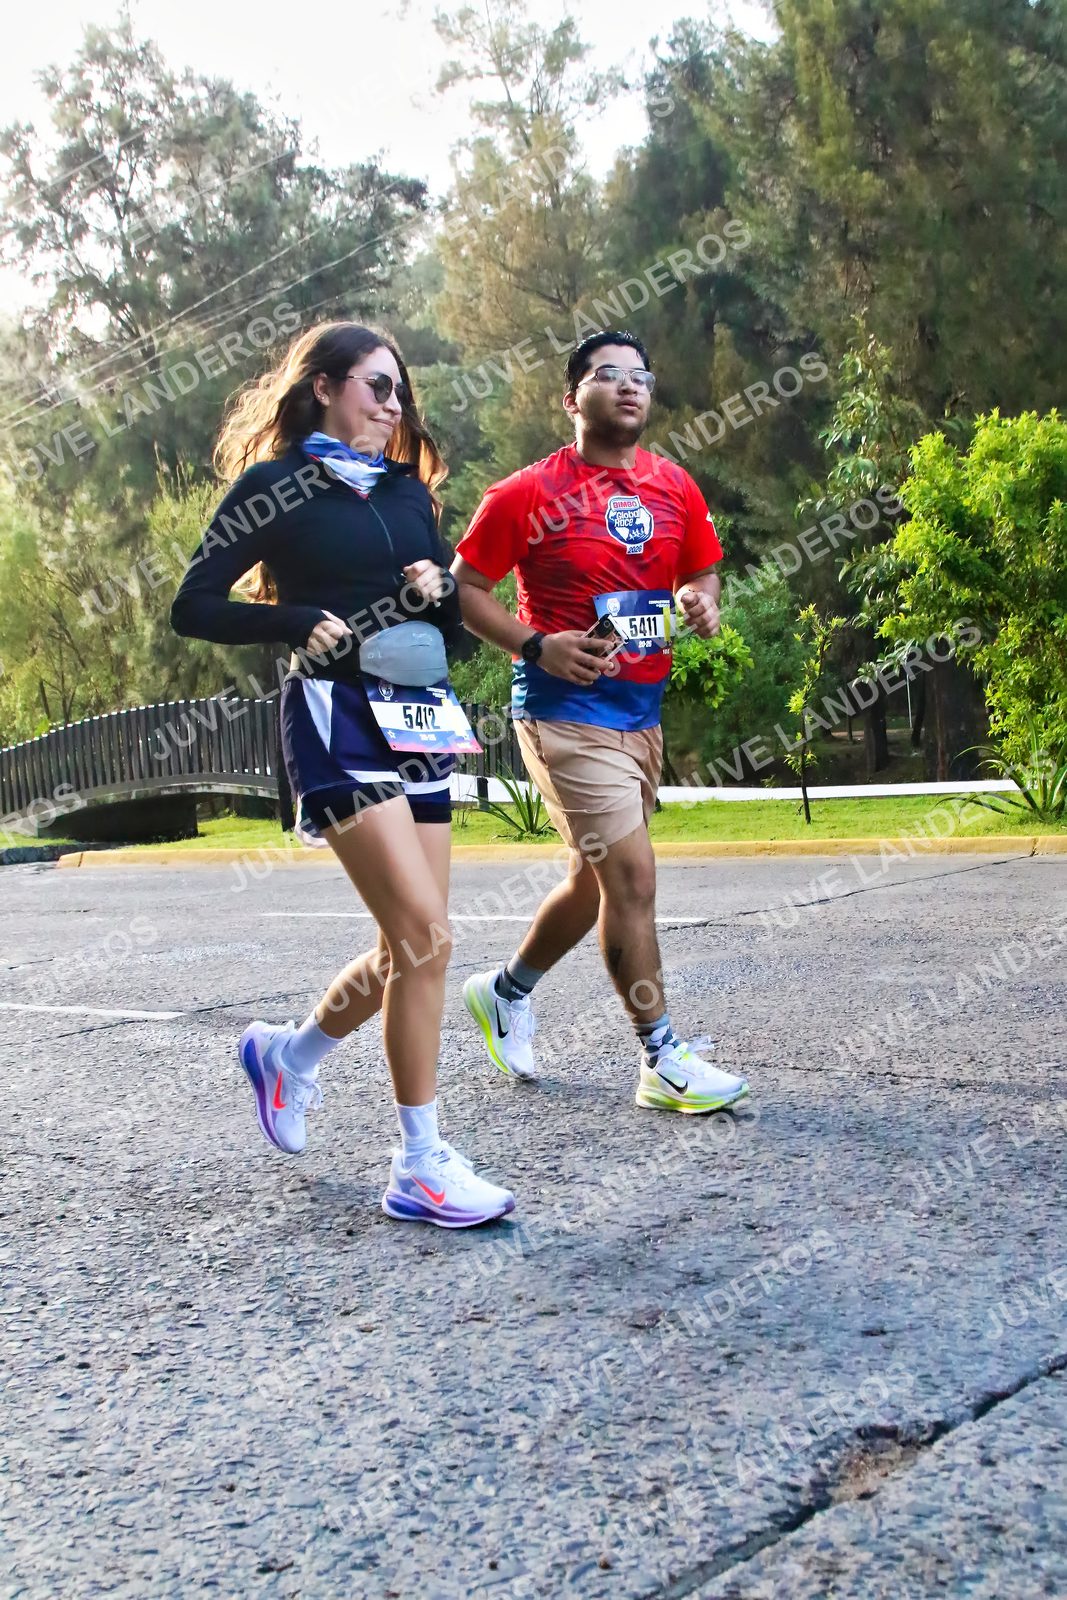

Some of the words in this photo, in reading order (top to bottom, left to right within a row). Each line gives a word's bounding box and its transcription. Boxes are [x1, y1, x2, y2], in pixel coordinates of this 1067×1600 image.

[614, 518, 634, 527] Race
[629, 616, 657, 637] 5411
[402, 705, 441, 730] 5412
